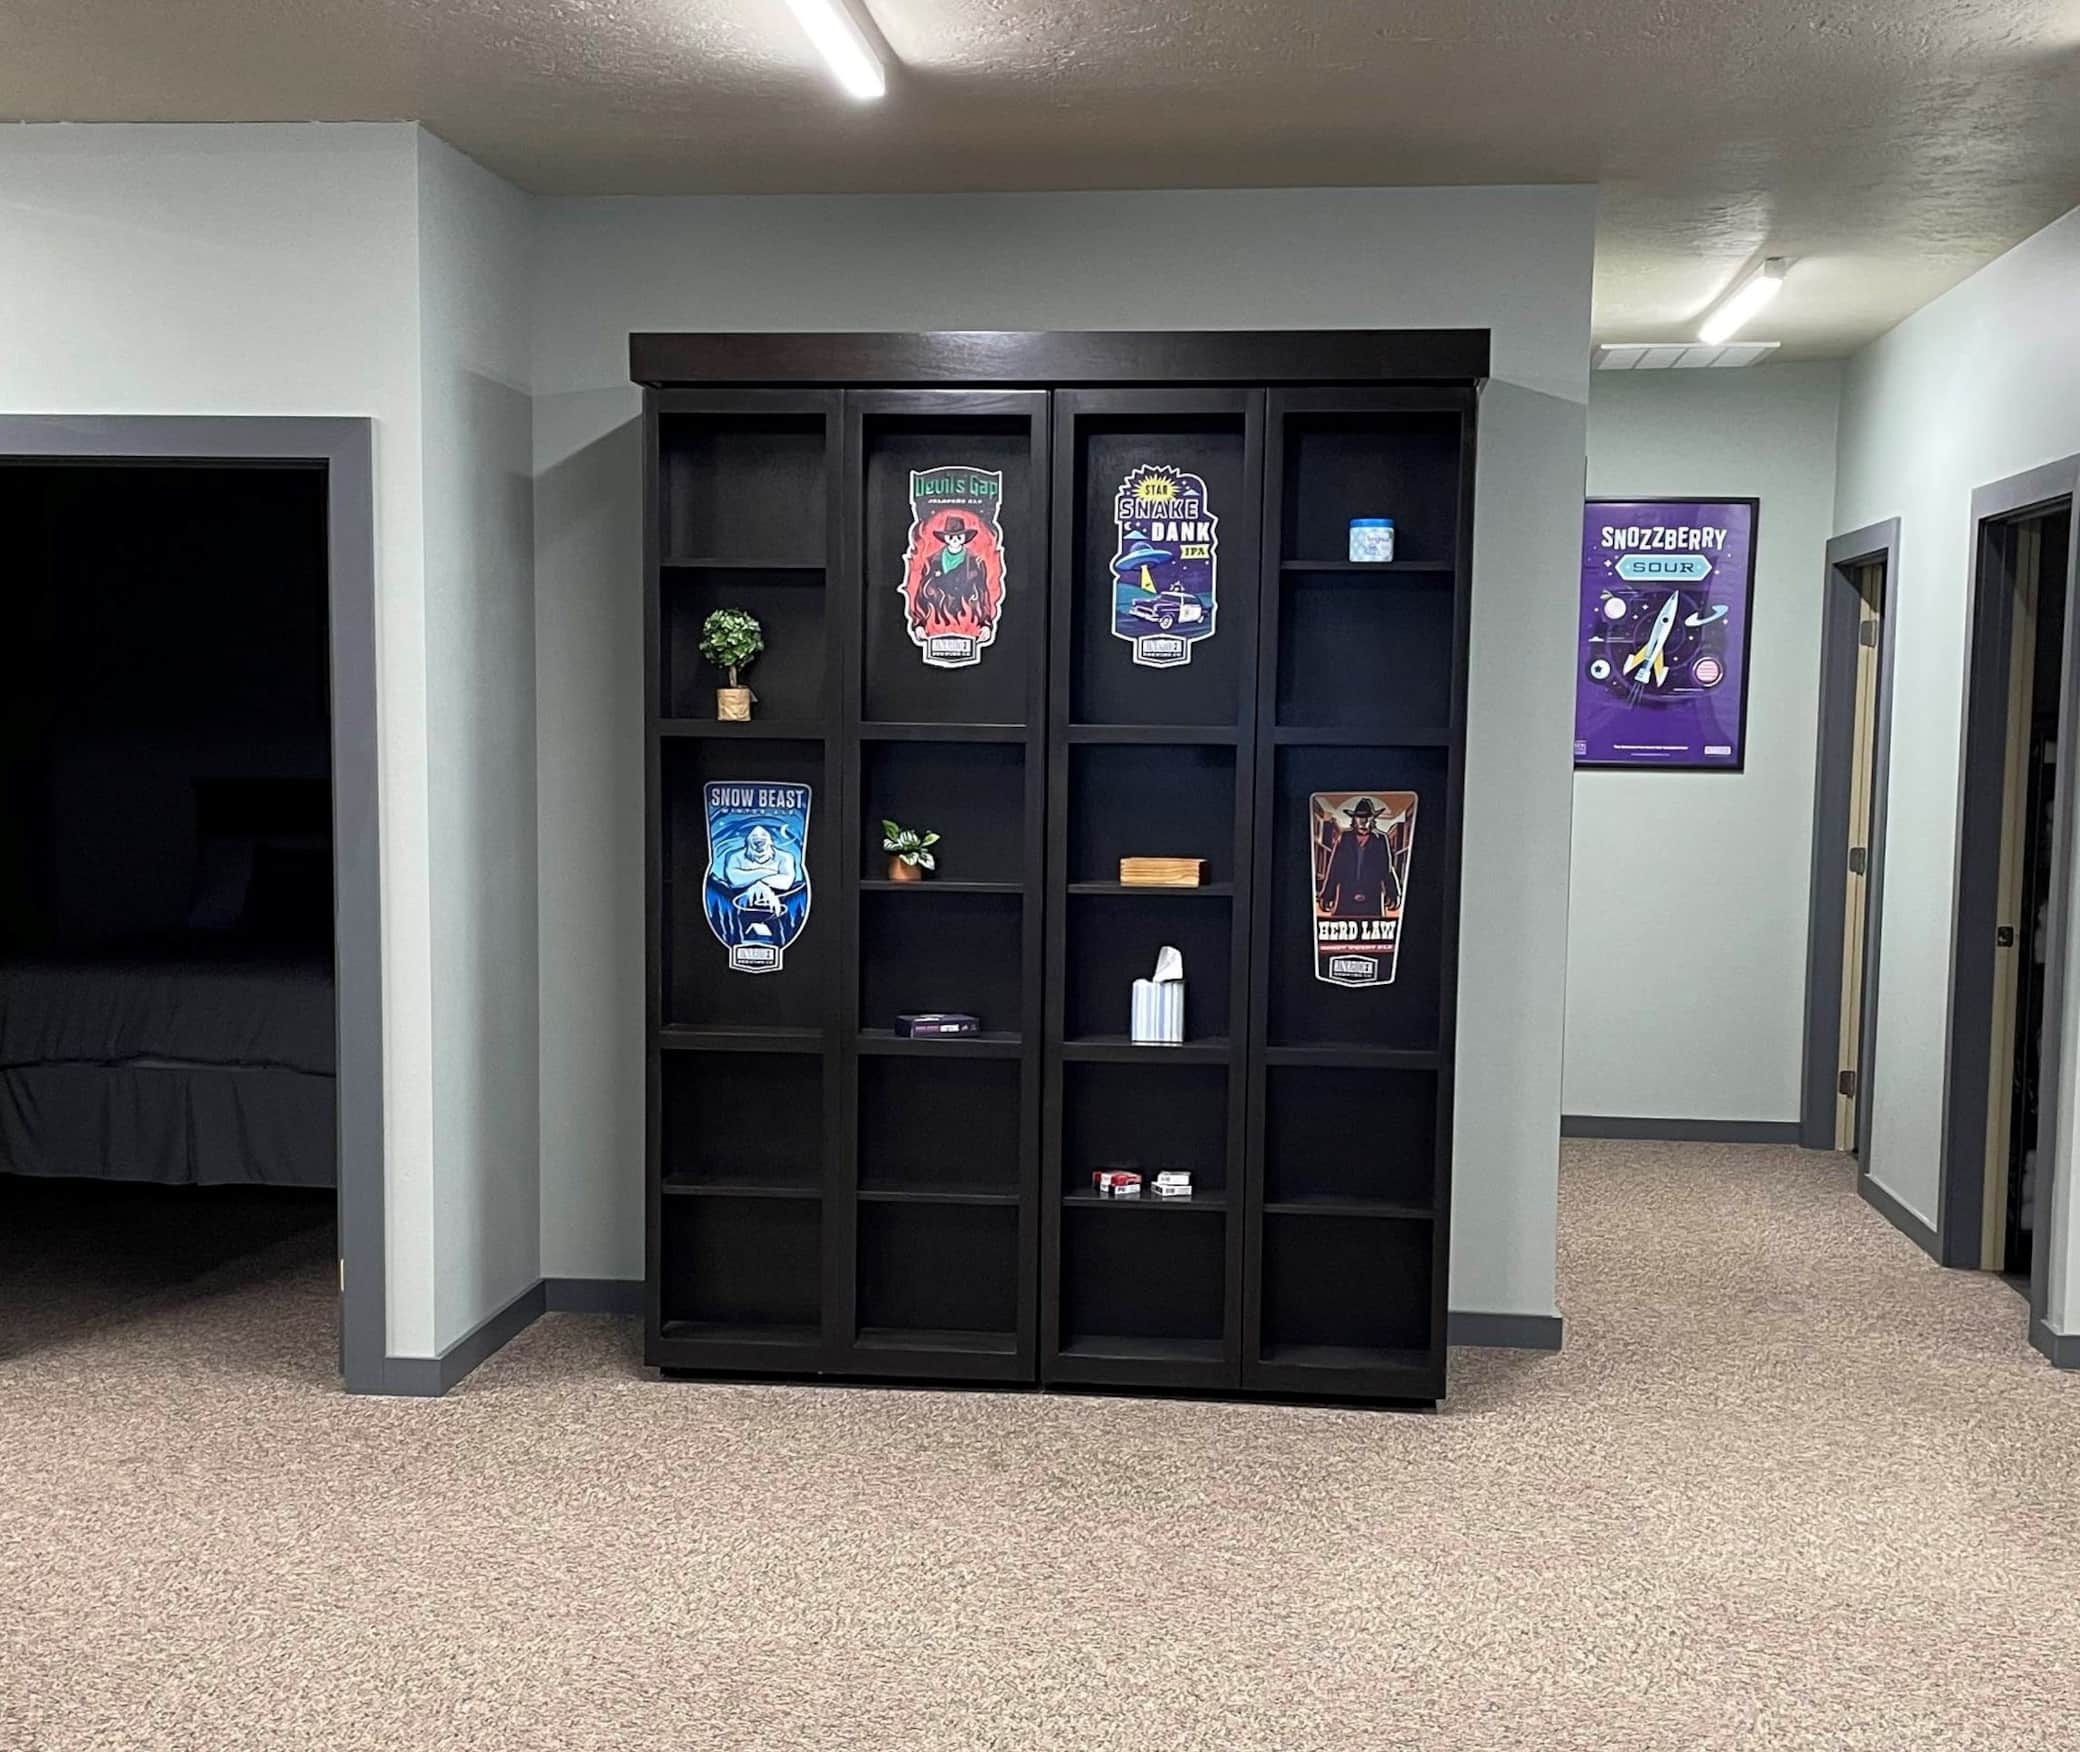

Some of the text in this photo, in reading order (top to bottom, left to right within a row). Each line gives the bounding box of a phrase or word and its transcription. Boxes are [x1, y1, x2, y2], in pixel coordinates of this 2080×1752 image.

[970, 475, 998, 499] Gap
[1145, 485, 1168, 495] STAR
[1120, 498, 1199, 519] SNAKE
[1151, 521, 1210, 541] DANK
[1601, 526, 1727, 550] SNOZZBERRY
[1185, 547, 1206, 556] IPA
[1632, 561, 1695, 573] SOUR
[711, 788, 804, 808] SNOW BEAST
[1318, 921, 1397, 941] HERD LAW
